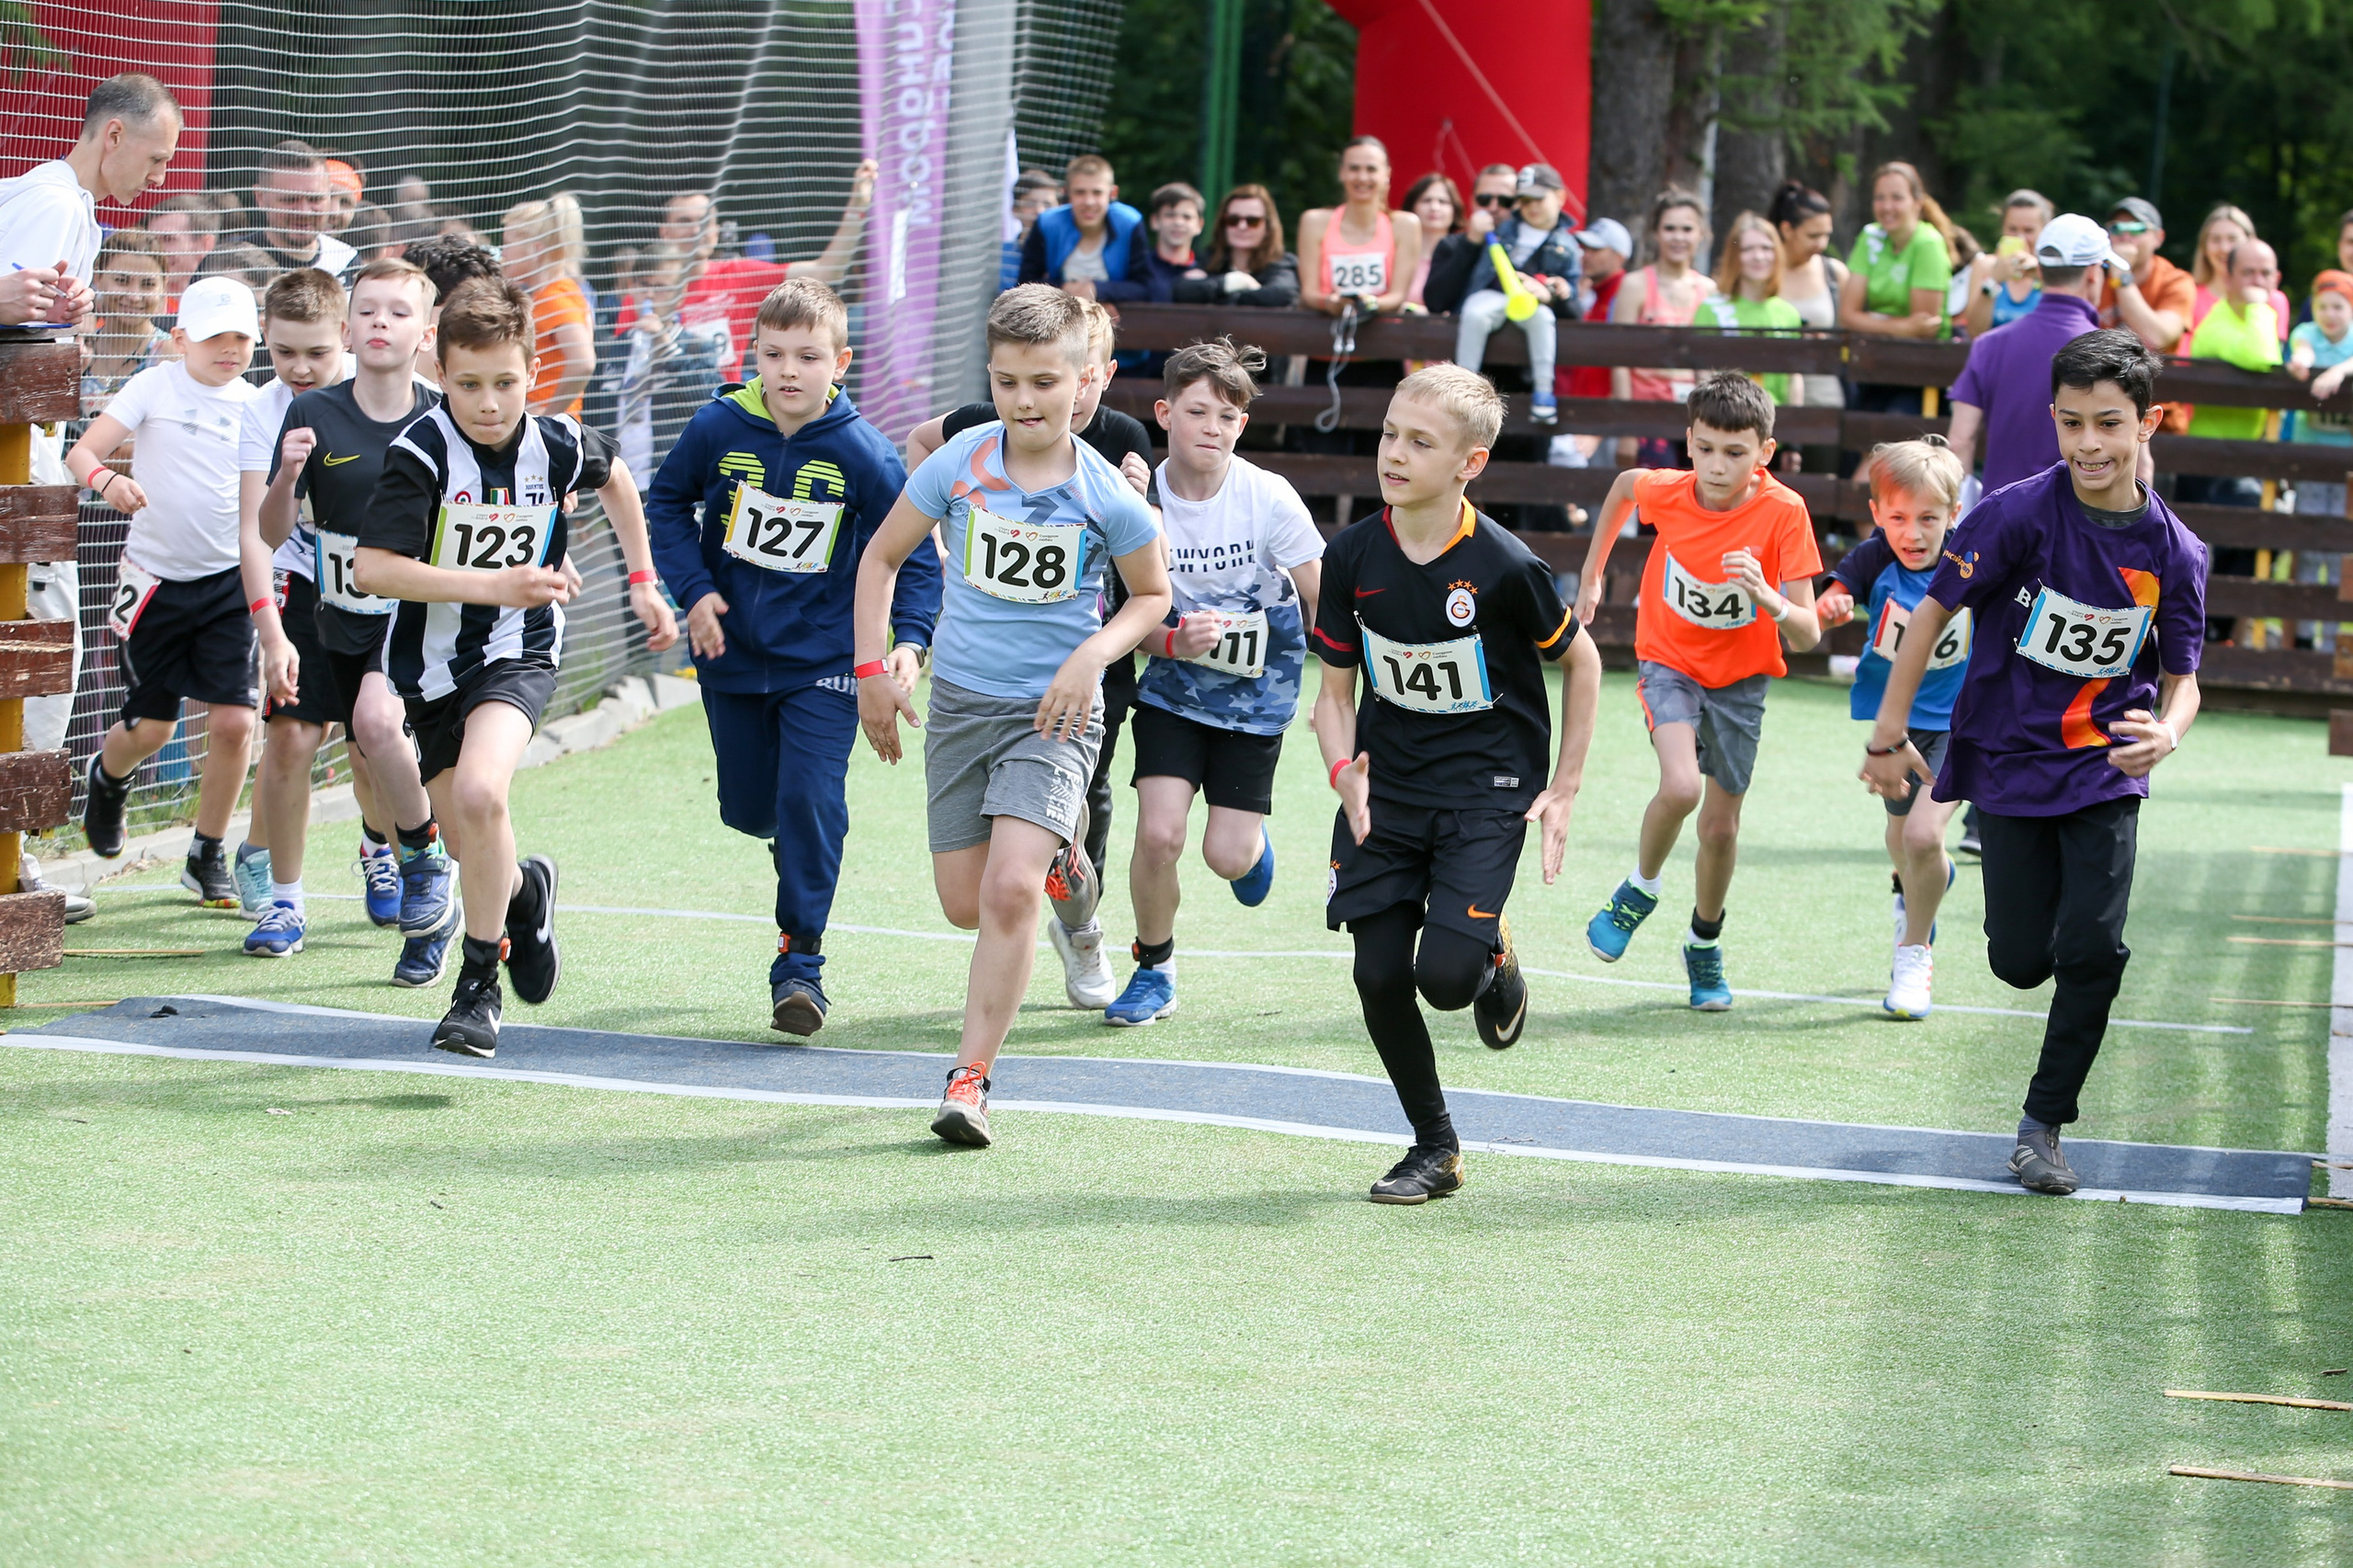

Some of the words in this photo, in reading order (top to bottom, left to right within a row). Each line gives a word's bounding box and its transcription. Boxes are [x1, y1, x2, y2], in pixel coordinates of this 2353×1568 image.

[1336, 265, 1381, 287] 285
[454, 523, 536, 569] 123
[747, 506, 824, 559] 127
[981, 532, 1066, 589] 128
[1675, 575, 1744, 619] 134
[1894, 621, 1959, 659] 16
[2045, 612, 2131, 666] 135
[1382, 654, 1462, 701] 141
